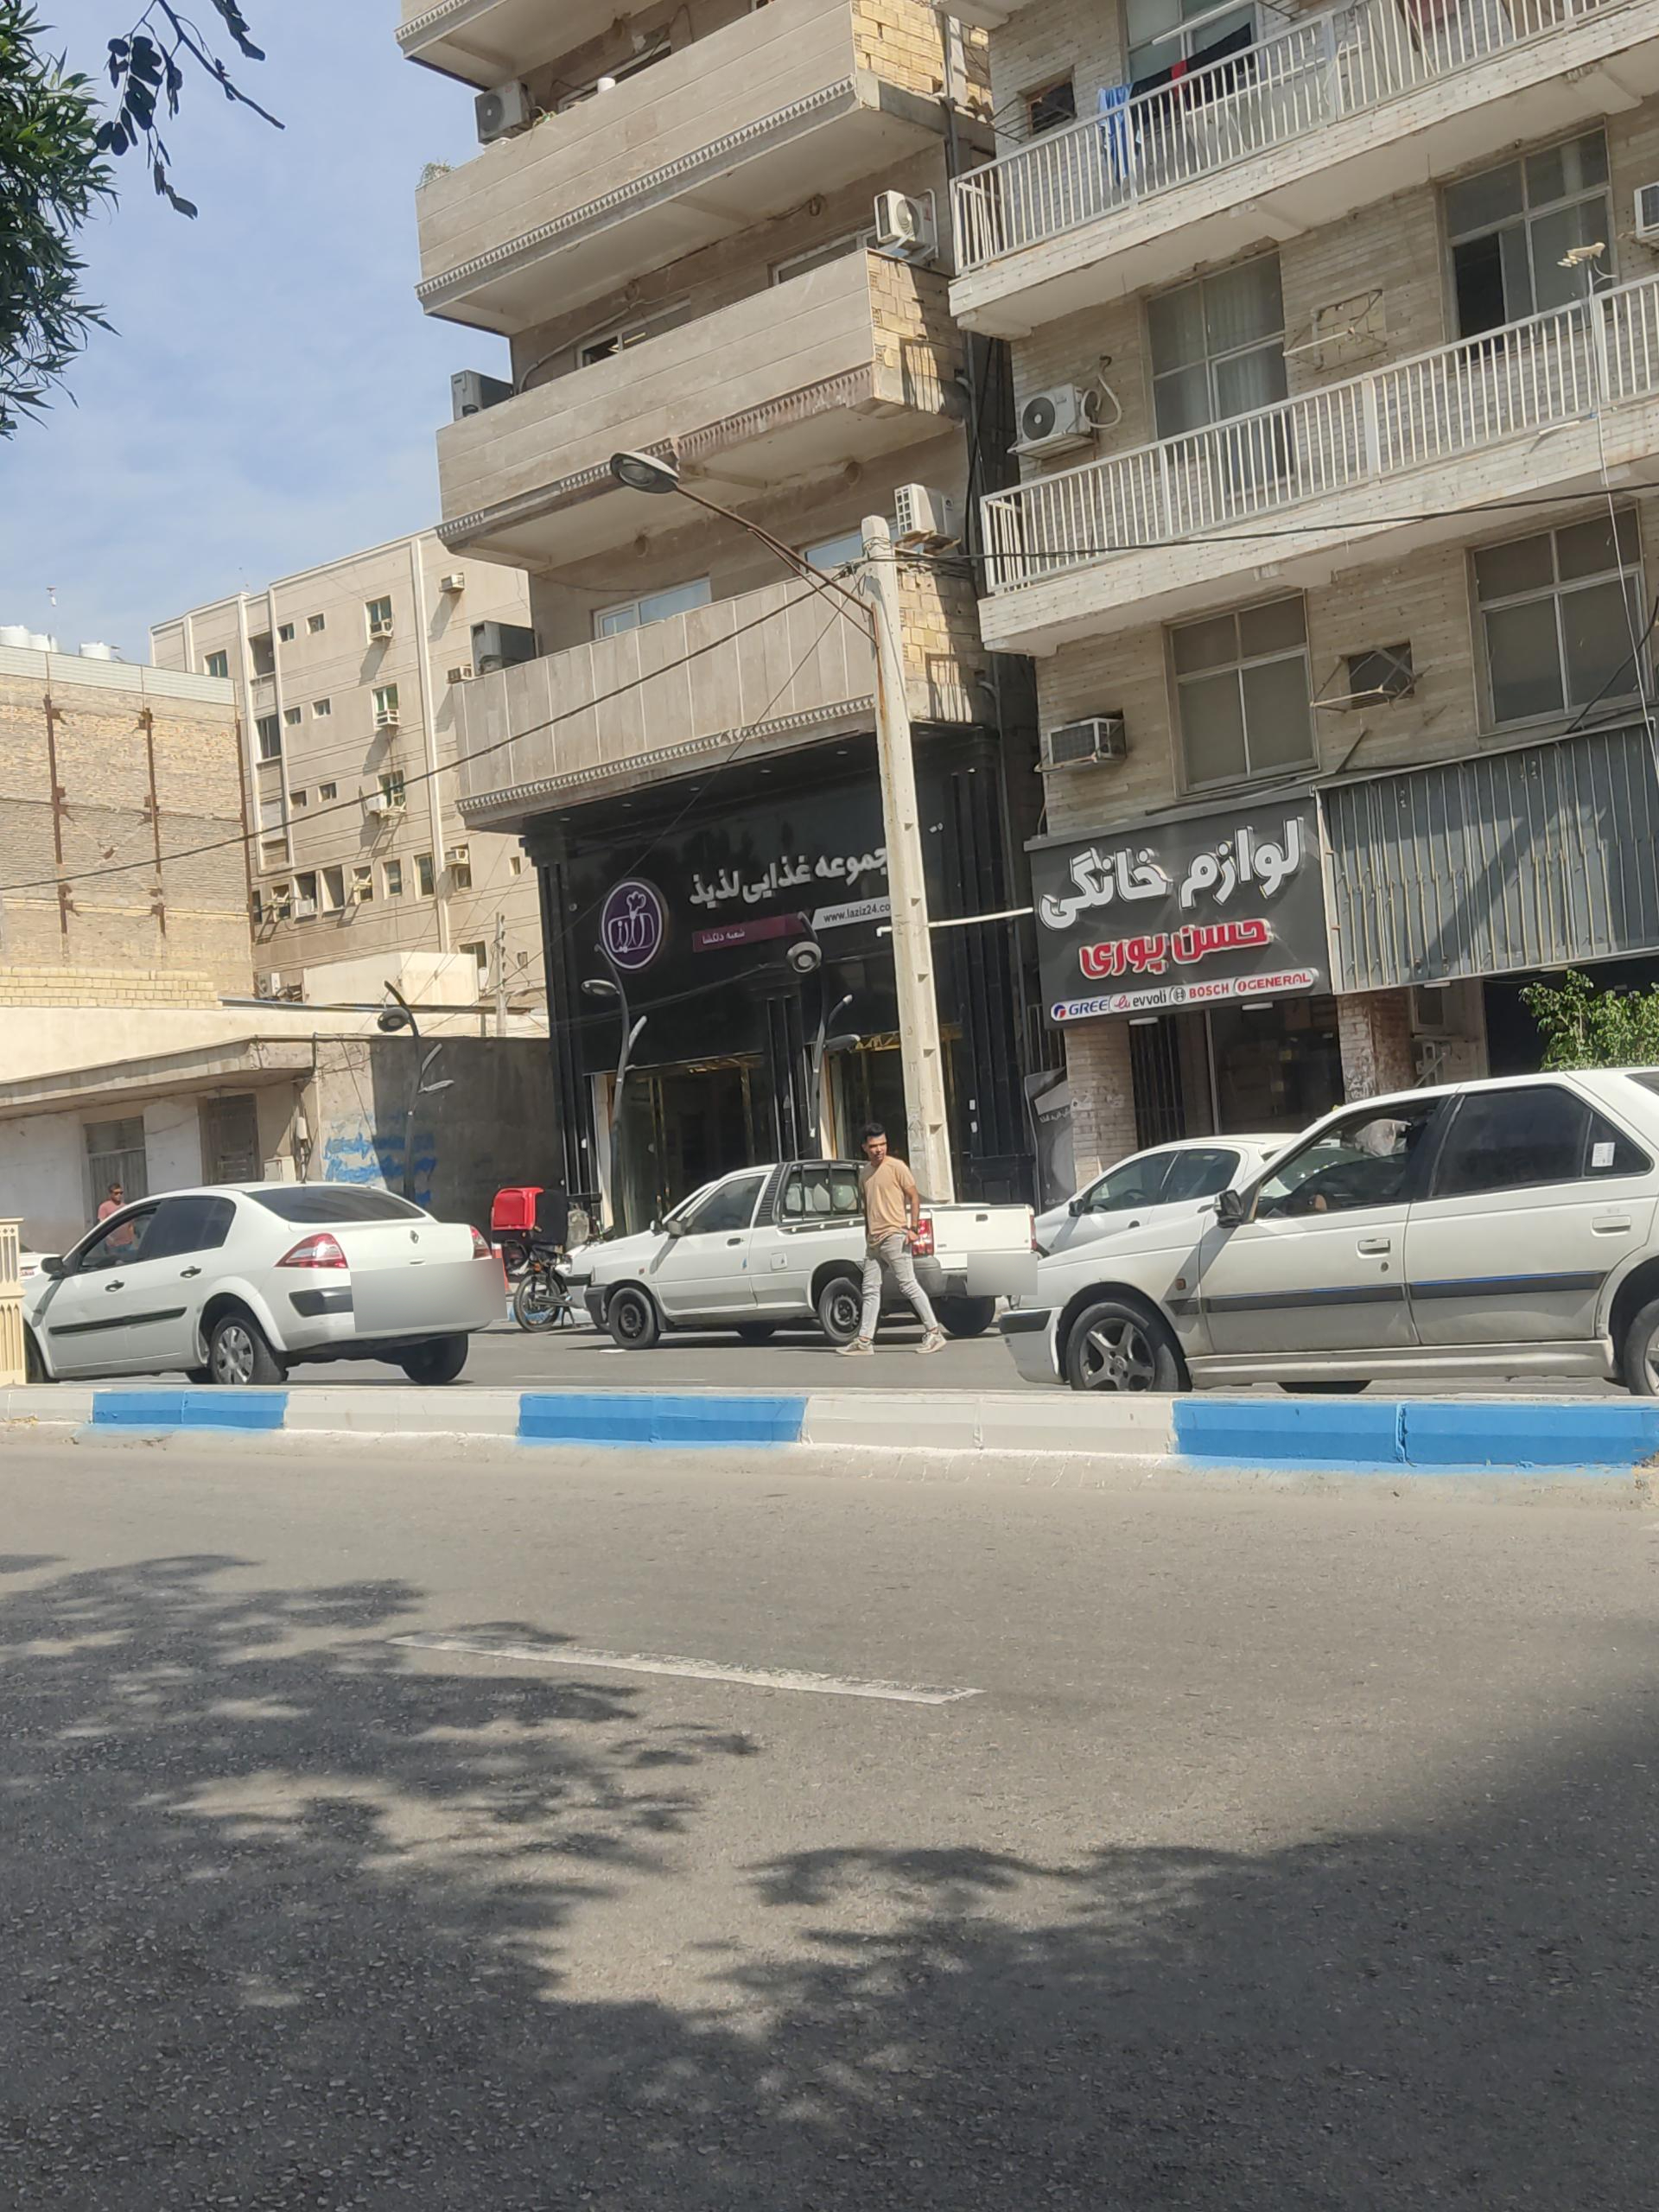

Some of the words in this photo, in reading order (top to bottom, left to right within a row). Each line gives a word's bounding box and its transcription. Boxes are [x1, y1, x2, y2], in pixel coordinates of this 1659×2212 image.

[742, 855, 812, 904] غذایی
[815, 847, 887, 886] جموعه
[1179, 817, 1305, 909] لوازم
[689, 868, 740, 910] لذیذ
[1039, 846, 1173, 930] خانگی
[726, 927, 746, 941] شعبه
[823, 903, 891, 923] www.laziz24.co
[1079, 933, 1172, 981] پوری
[1172, 918, 1274, 964] حسن
[1068, 999, 1109, 1016] GREE
[1132, 991, 1167, 1007] evvoli
[1188, 982, 1230, 1000] BOSCH
[1247, 969, 1312, 991] GENERAL
